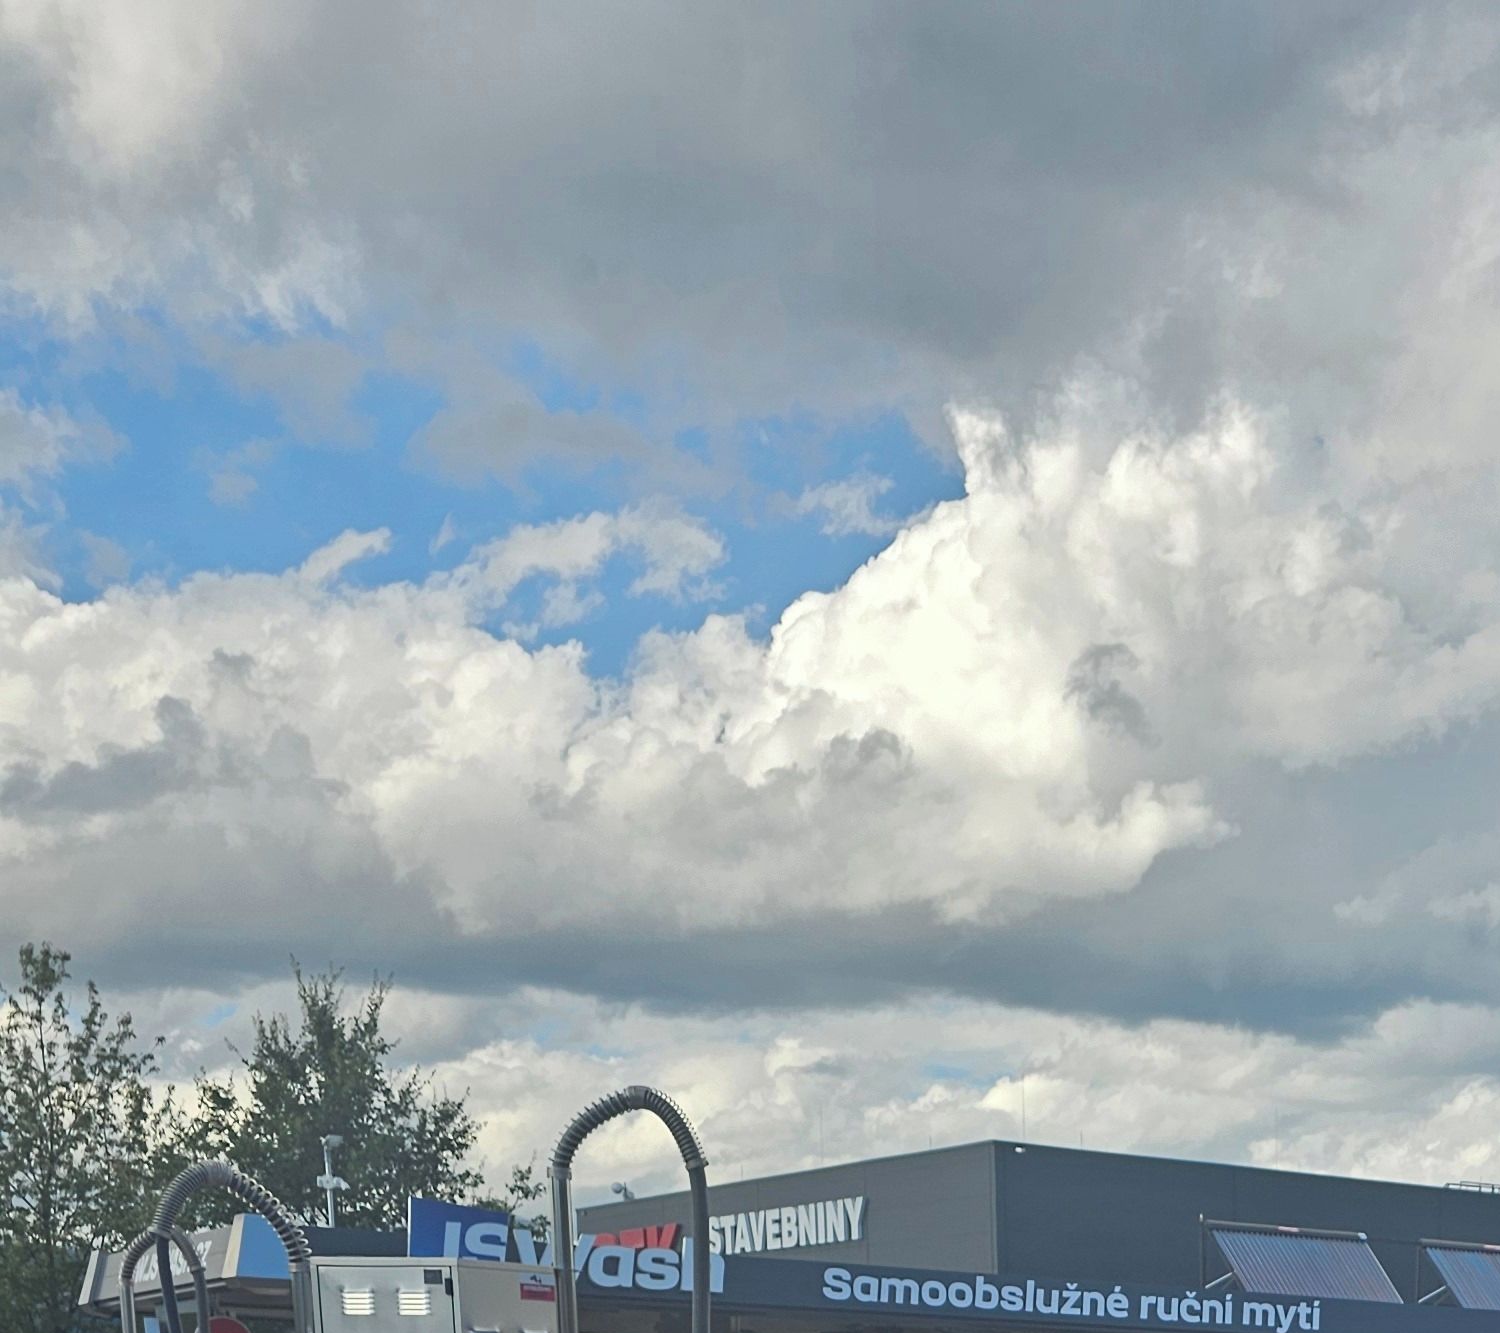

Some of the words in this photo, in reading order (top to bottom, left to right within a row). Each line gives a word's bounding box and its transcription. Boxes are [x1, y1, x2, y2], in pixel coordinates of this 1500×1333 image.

[709, 1196, 864, 1256] STAVEBNINY
[822, 1267, 1129, 1319] Samoobslužné
[1139, 1290, 1233, 1325] ruční
